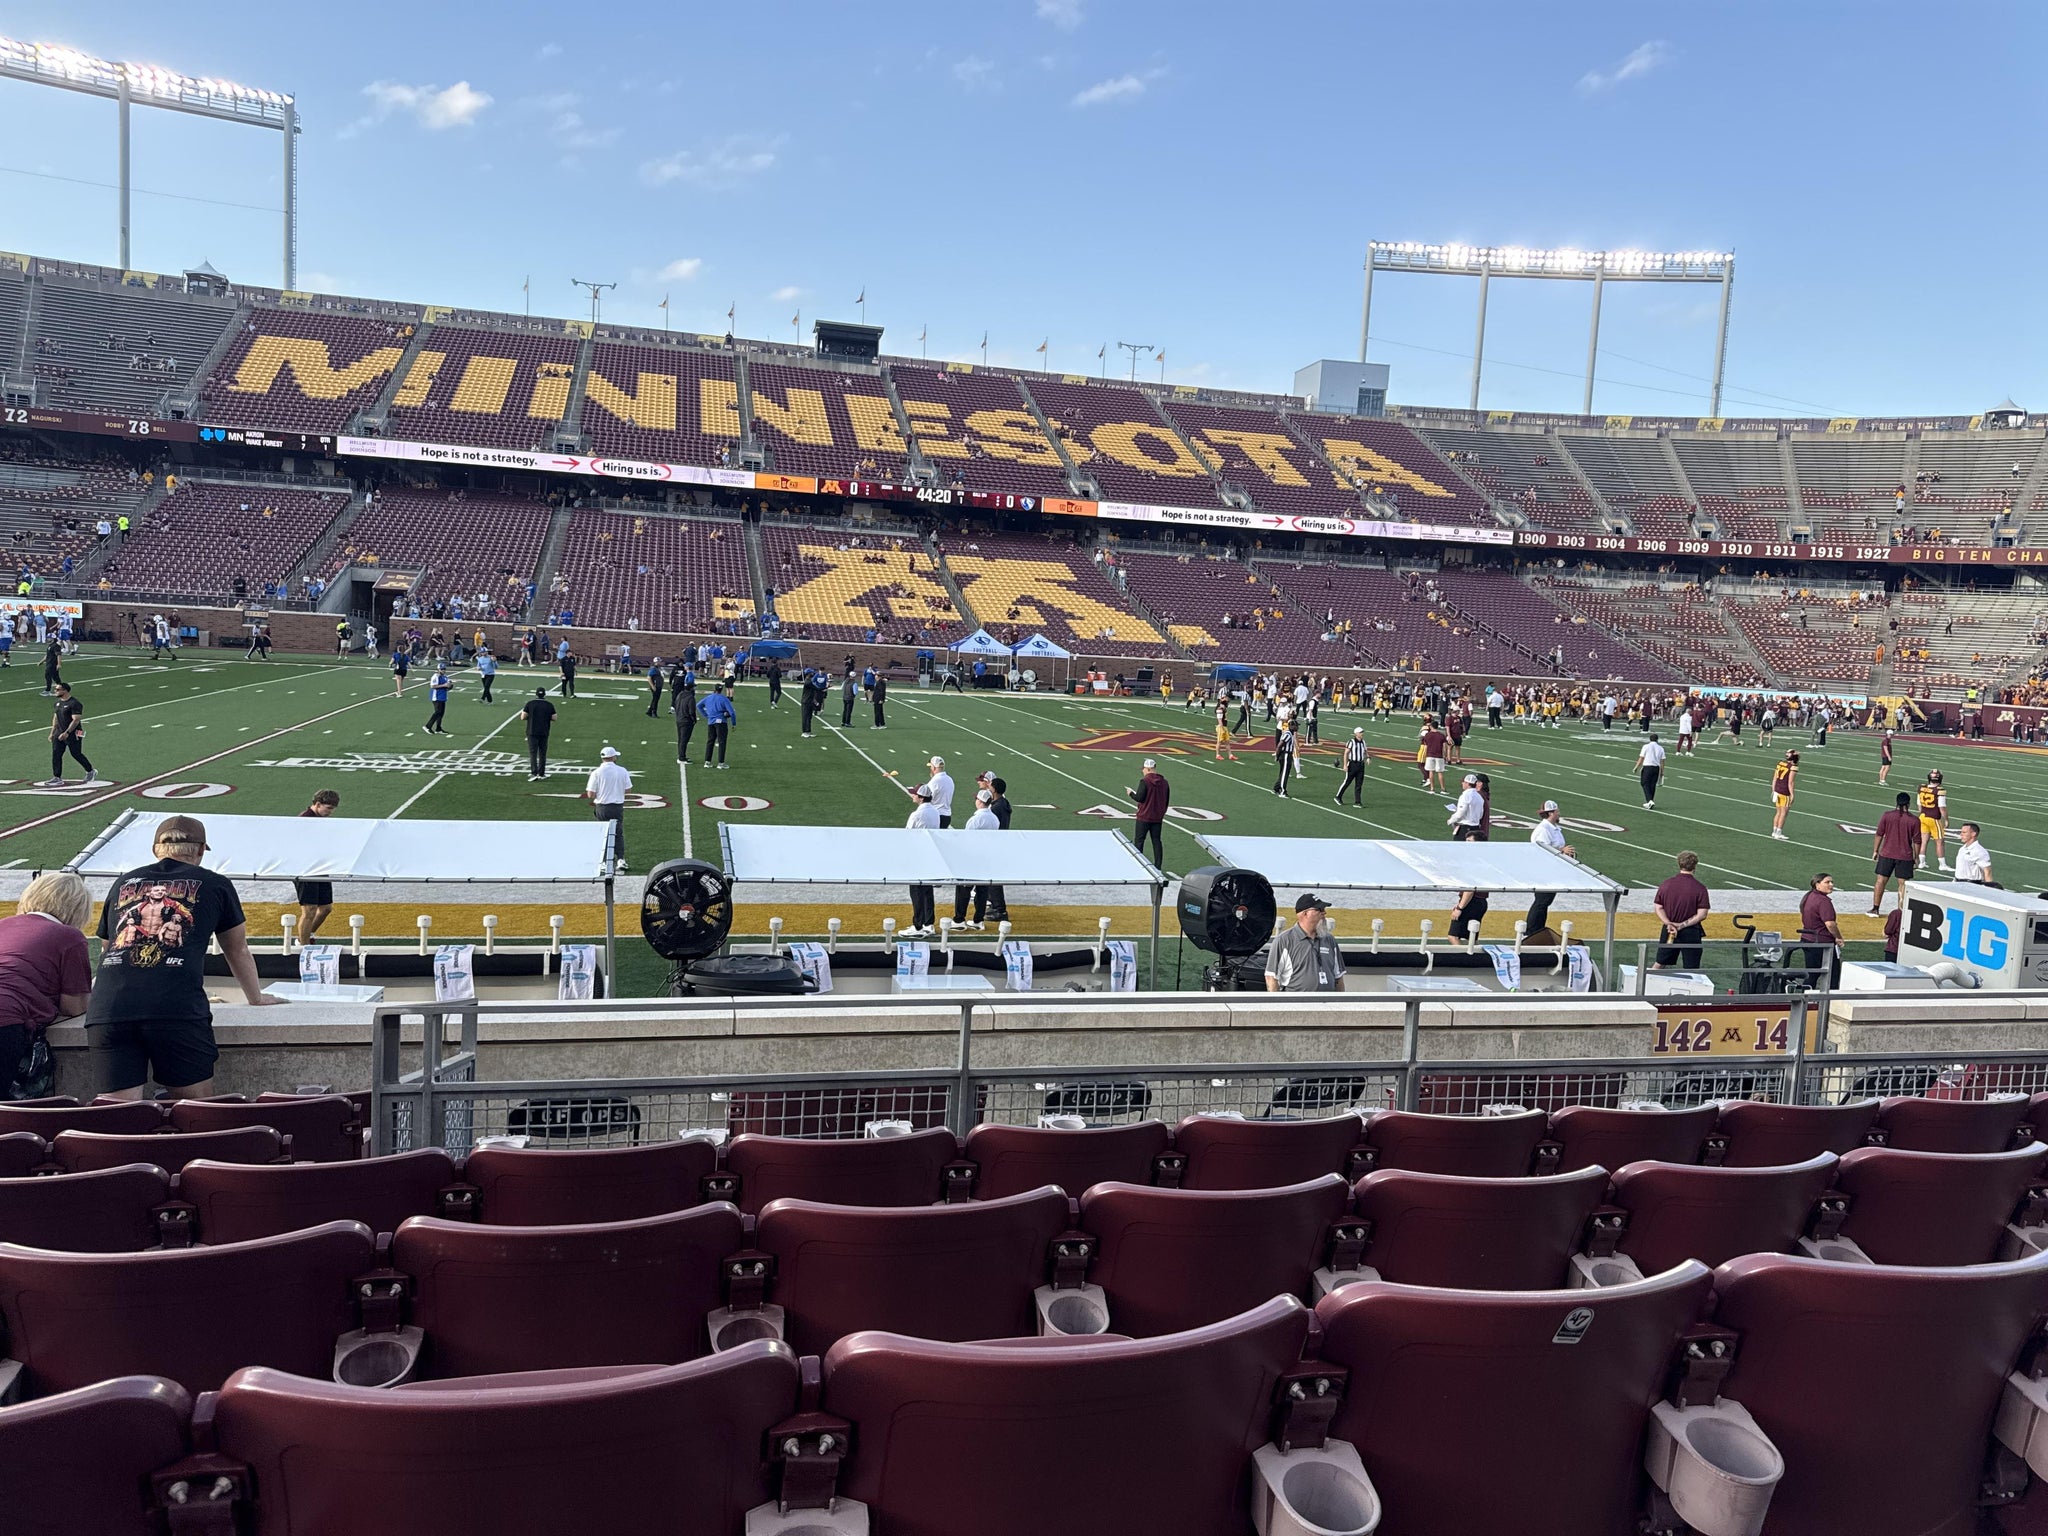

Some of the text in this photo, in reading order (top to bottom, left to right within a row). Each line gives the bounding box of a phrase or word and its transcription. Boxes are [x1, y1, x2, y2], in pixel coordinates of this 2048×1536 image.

[4, 408, 62, 423] 72 NAGURSKI
[226, 335, 1456, 499] MINNESOTA
[105, 421, 125, 429] BOBBY
[128, 420, 150, 435] 78
[227, 432, 244, 442] MN
[245, 431, 265, 439] AKRON
[245, 438, 261, 446] WAKE
[262, 440, 284, 448] FOREST
[421, 447, 449, 460] Hope
[451, 449, 460, 459] is
[463, 451, 481, 461] not
[491, 453, 538, 467] strategy.
[602, 462, 662, 476] Hiring us is.
[820, 480, 858, 495] M 0
[916, 487, 951, 504] 44:20
[1006, 495, 1014, 508] 0
[1161, 510, 1184, 520] Hope
[1185, 511, 1192, 520] is
[1194, 513, 1207, 521] not
[1215, 514, 1251, 525] strategy.
[1301, 520, 1325, 531] Hiring
[1518, 533, 1547, 545] 1900
[1557, 535, 1586, 547] 1903
[1595, 537, 1625, 549] 1904
[1637, 539, 1667, 551] 1906
[1678, 541, 1709, 553] 1909
[1720, 543, 1752, 555] 1910
[1765, 545, 1797, 557] 1911
[1810, 546, 1844, 558] 1915
[1856, 548, 1891, 560] 1927
[1913, 550, 2043, 562] BIG TEN CHA
[165, 957, 184, 966] UFC
[1653, 1018, 1713, 1053] 142
[1753, 1017, 1789, 1051] 14
[581, 1107, 625, 1124] OPS
